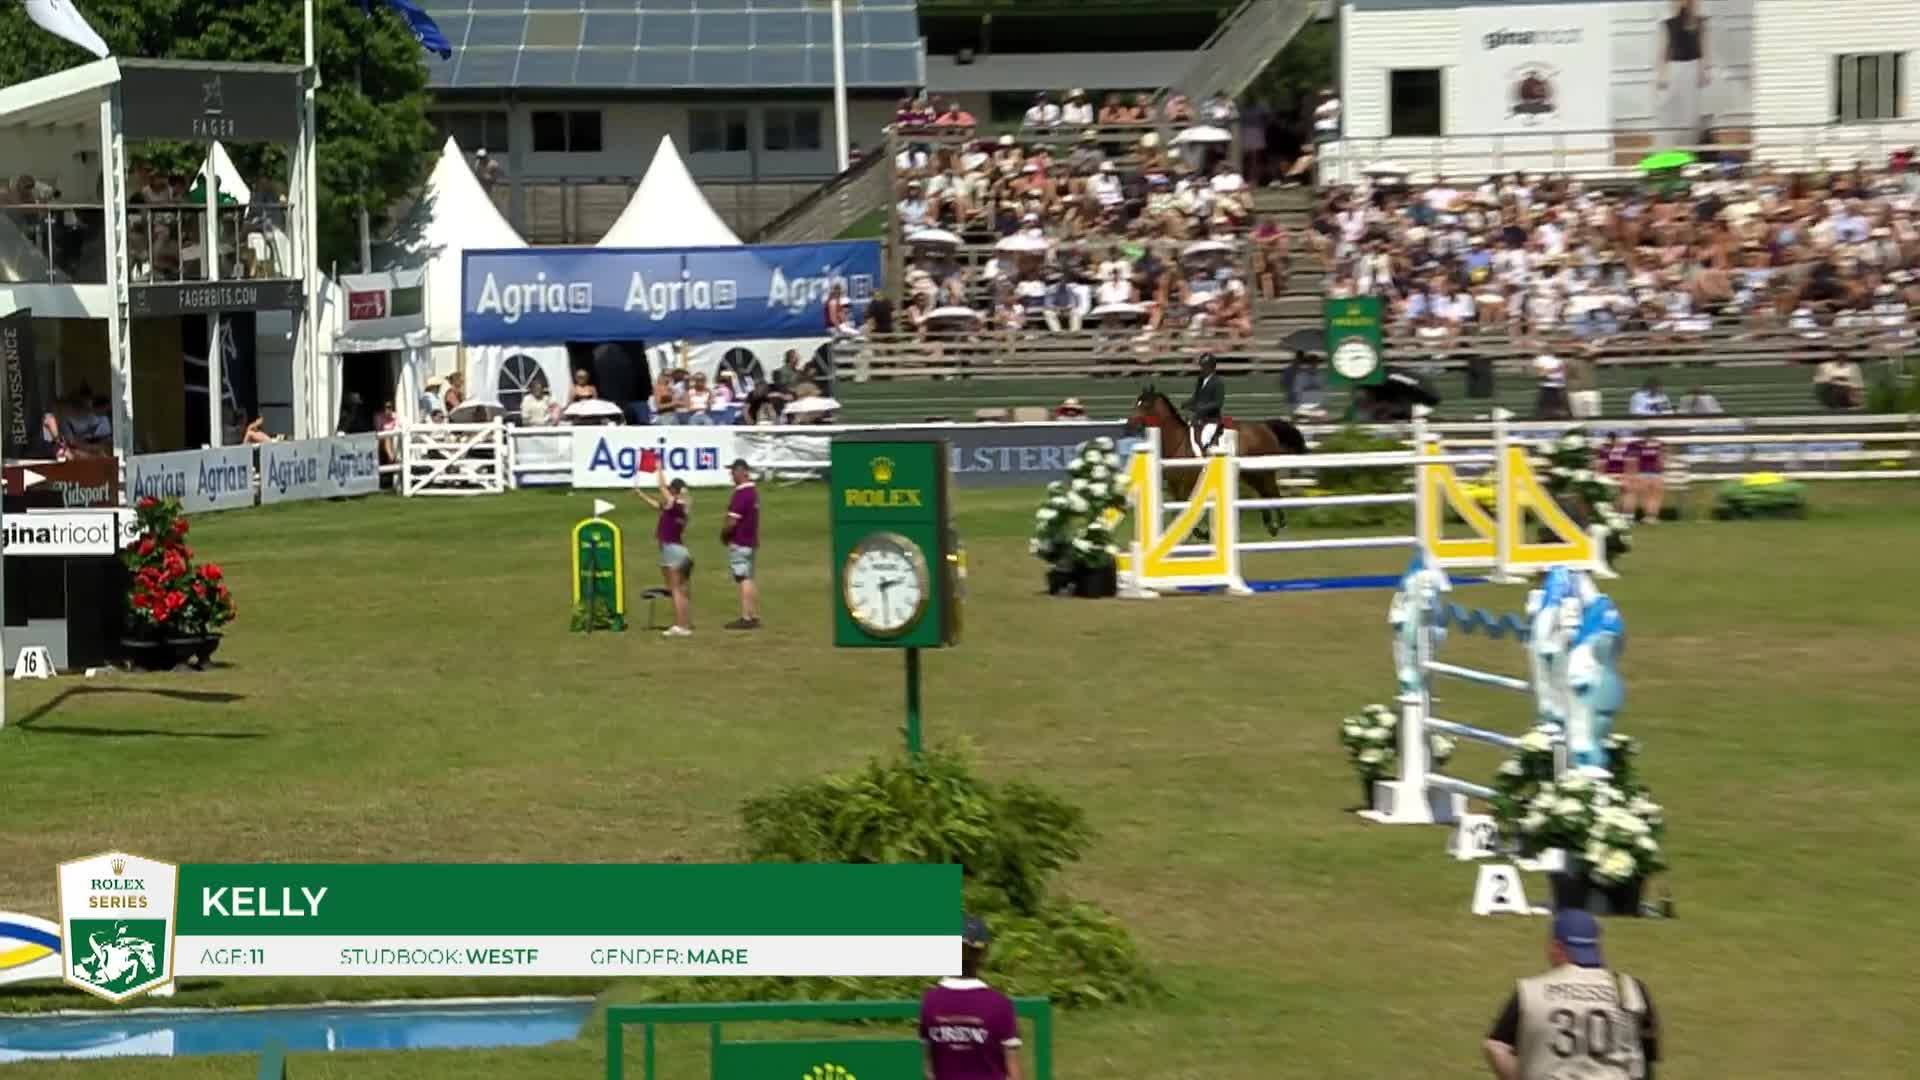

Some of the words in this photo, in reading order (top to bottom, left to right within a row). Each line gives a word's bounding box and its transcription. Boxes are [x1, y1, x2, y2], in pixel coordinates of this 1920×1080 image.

[193, 119, 234, 136] FAGER
[178, 287, 257, 308] FAGERBITS.COM
[476, 271, 567, 324] Agria
[624, 269, 711, 320] Agria
[4, 327, 29, 446] RENAISSANCE
[267, 450, 306, 493] Agria
[589, 436, 690, 479] Agia
[51, 480, 109, 508] Ridsport
[197, 456, 238, 502] Agria
[845, 488, 922, 507] ROLEX
[23, 651, 37, 673] 16
[1490, 873, 1511, 904] 2
[928, 1025, 989, 1044] CREW
